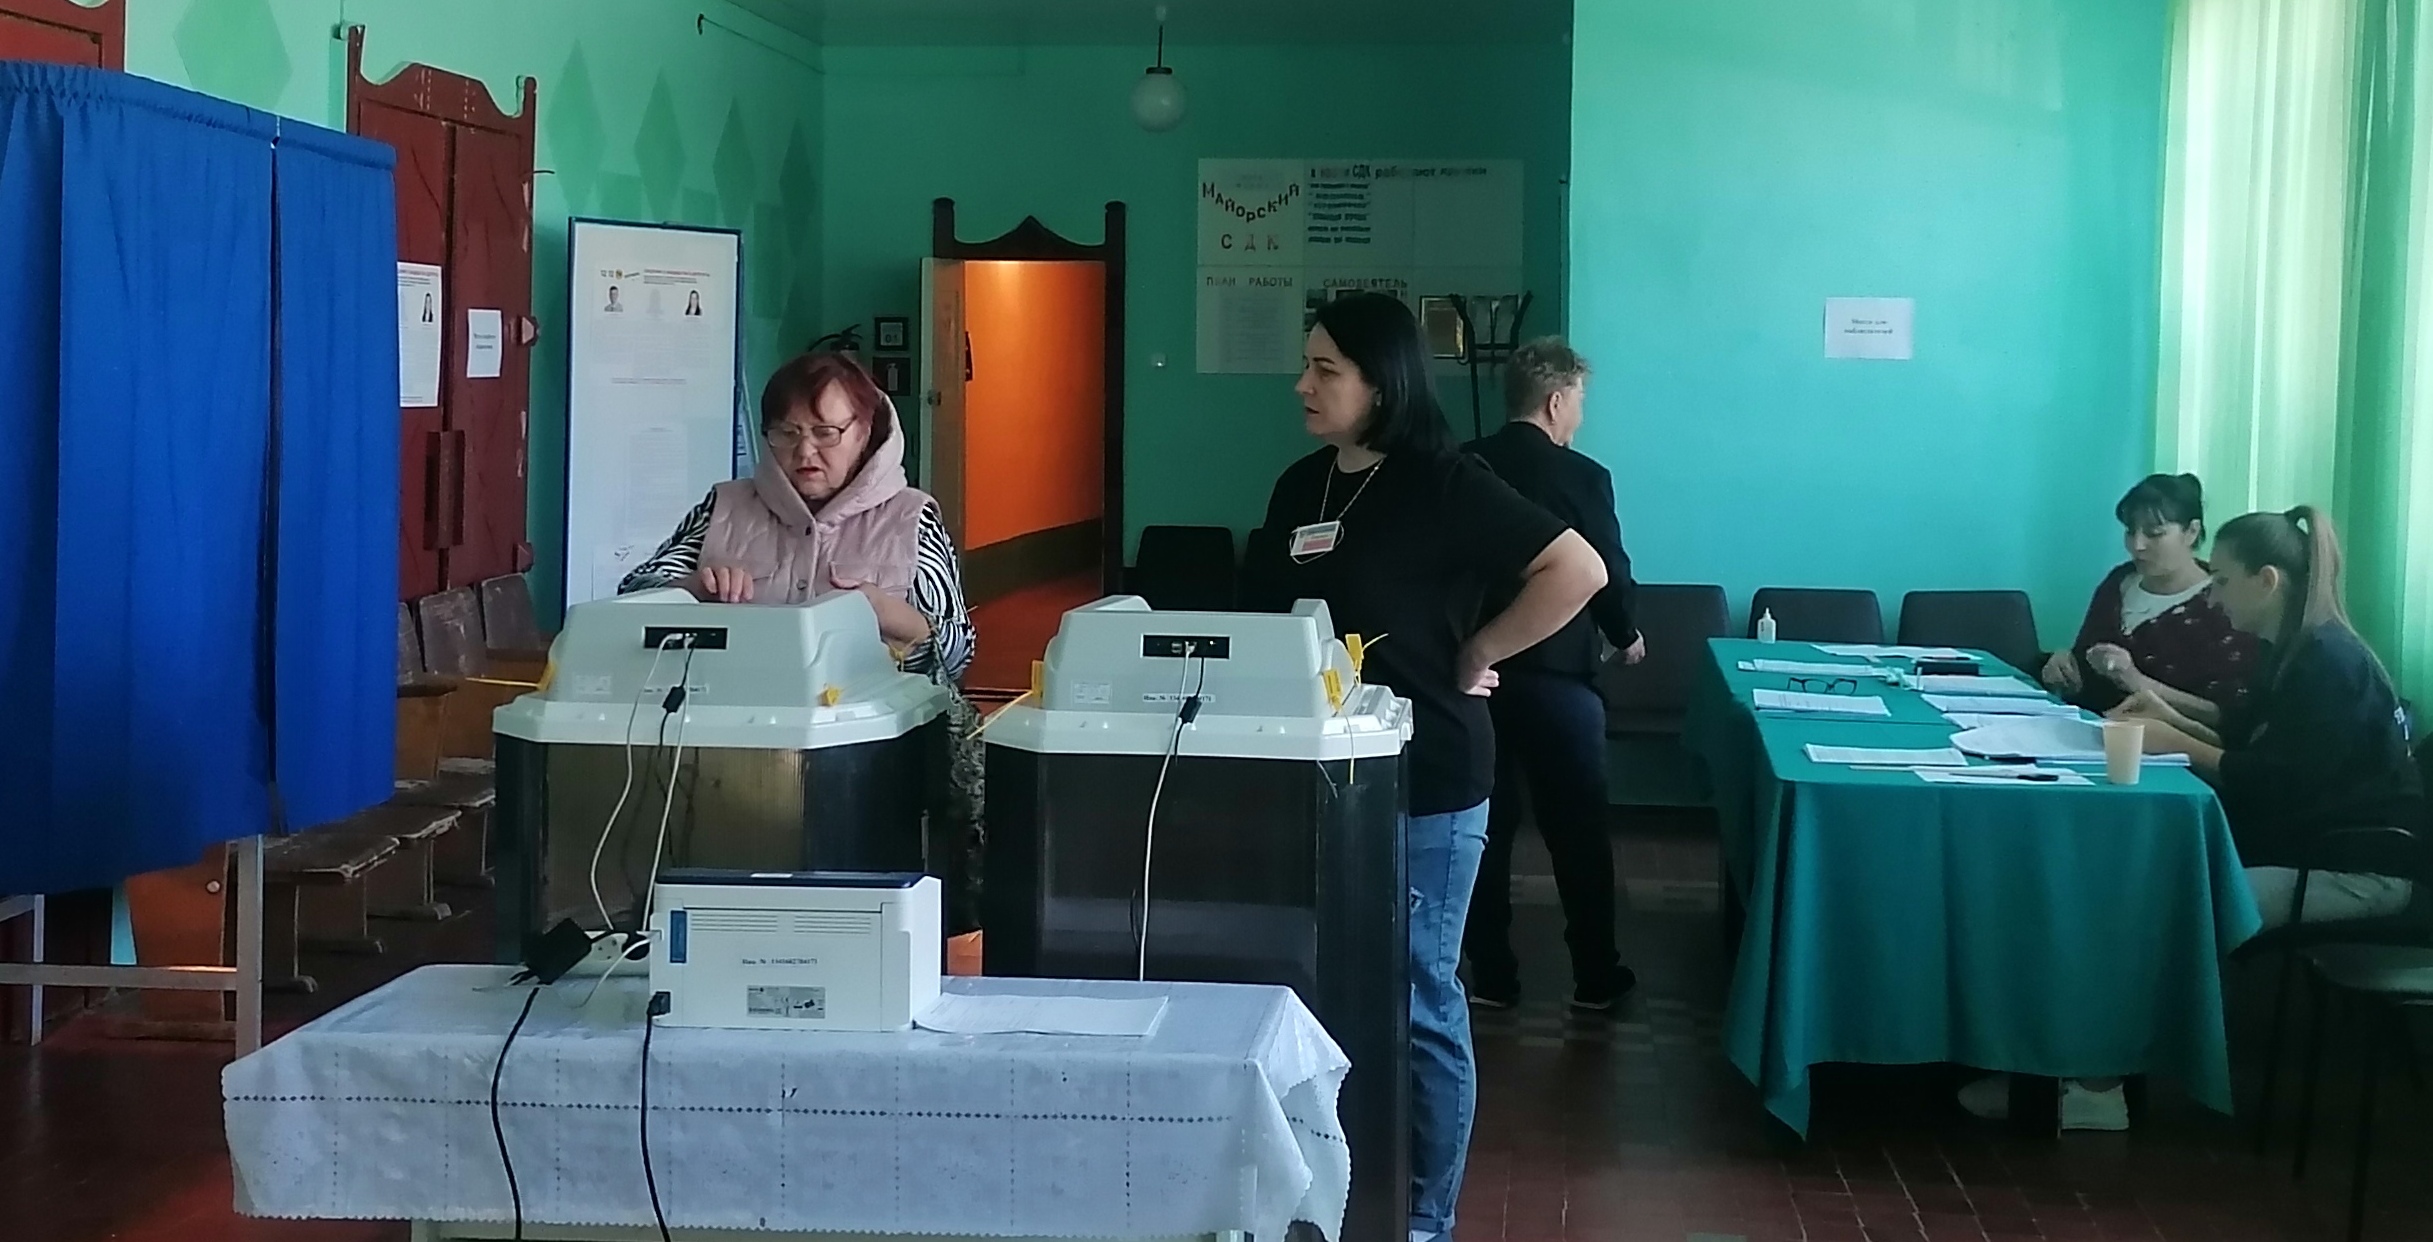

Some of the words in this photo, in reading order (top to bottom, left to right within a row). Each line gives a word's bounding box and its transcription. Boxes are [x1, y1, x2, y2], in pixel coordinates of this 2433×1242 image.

[1352, 164, 1371, 179] СДК
[1375, 165, 1436, 180] рабают
[1202, 182, 1300, 223] МАЙОРСКИЙ
[1249, 276, 1293, 287] РАБОТЫ
